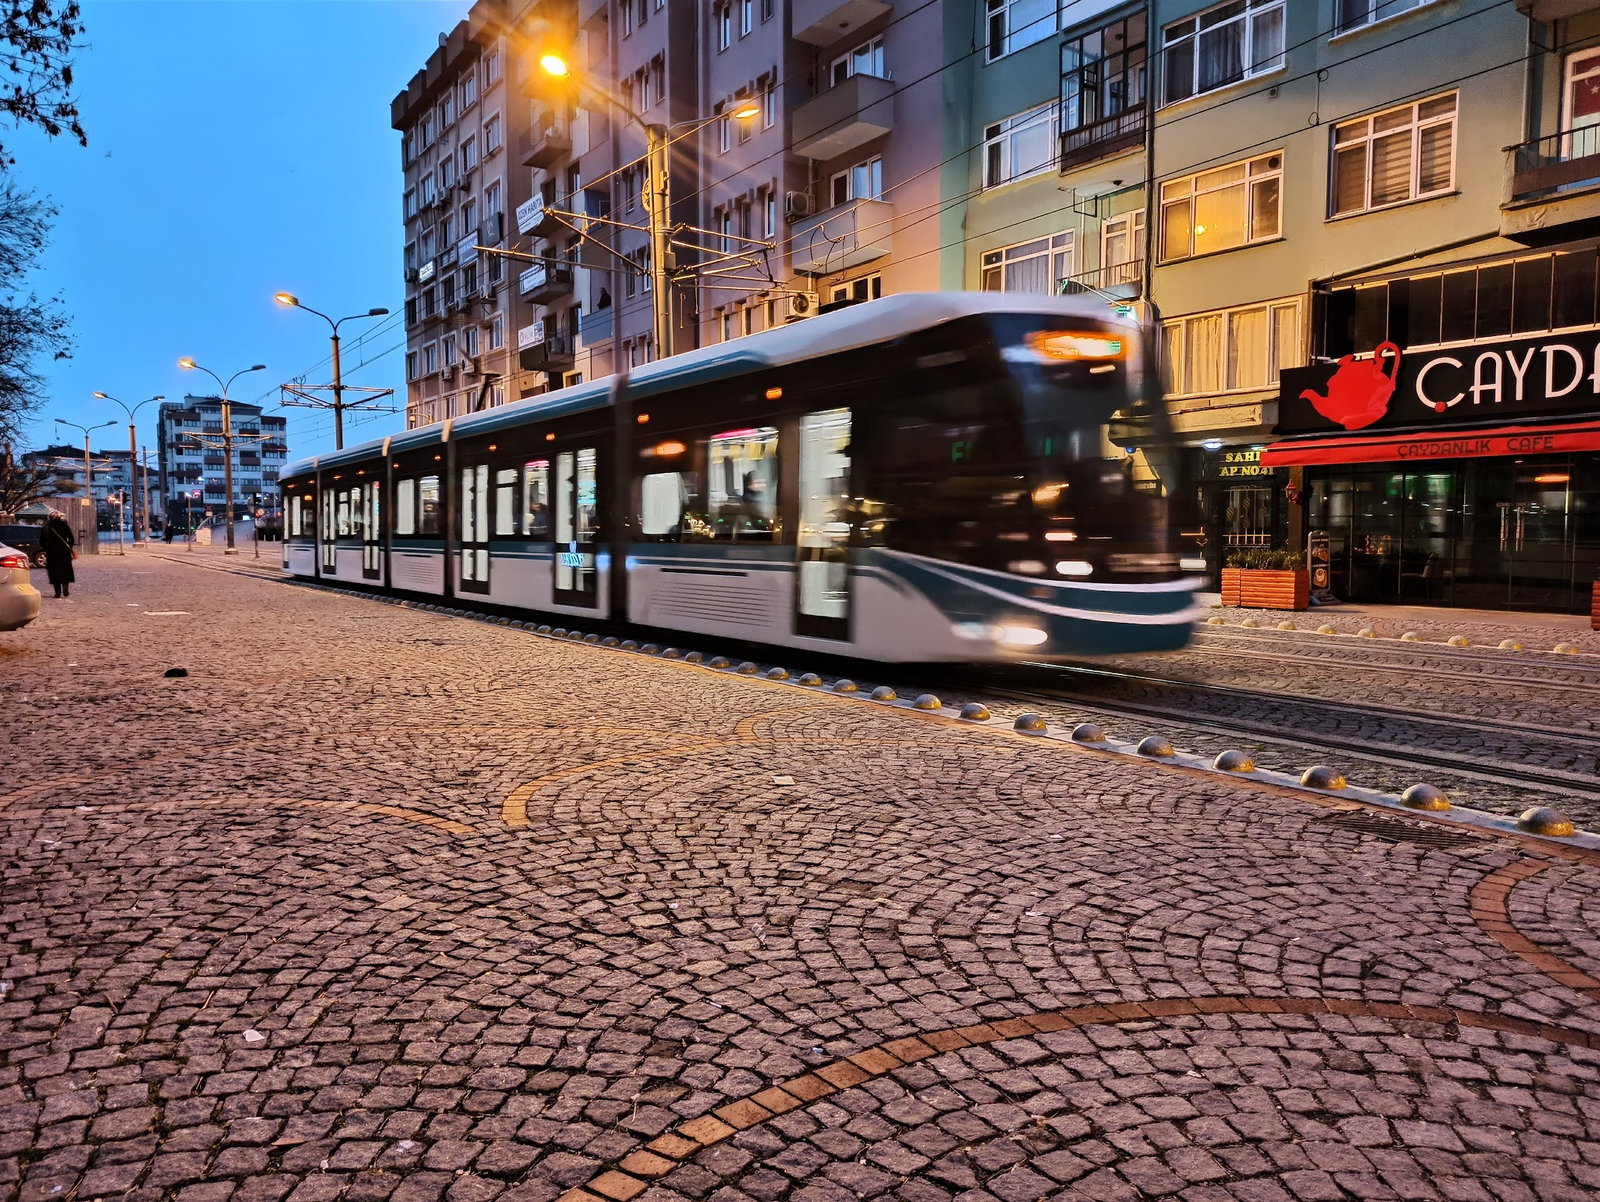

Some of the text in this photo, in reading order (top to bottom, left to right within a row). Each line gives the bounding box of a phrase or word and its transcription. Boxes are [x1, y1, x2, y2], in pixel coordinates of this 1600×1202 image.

[1416, 342, 1600, 414] ÇAYD
[1397, 435, 1554, 459] ÇAYDANLIK CAFE
[1220, 466, 1238, 476] AP
